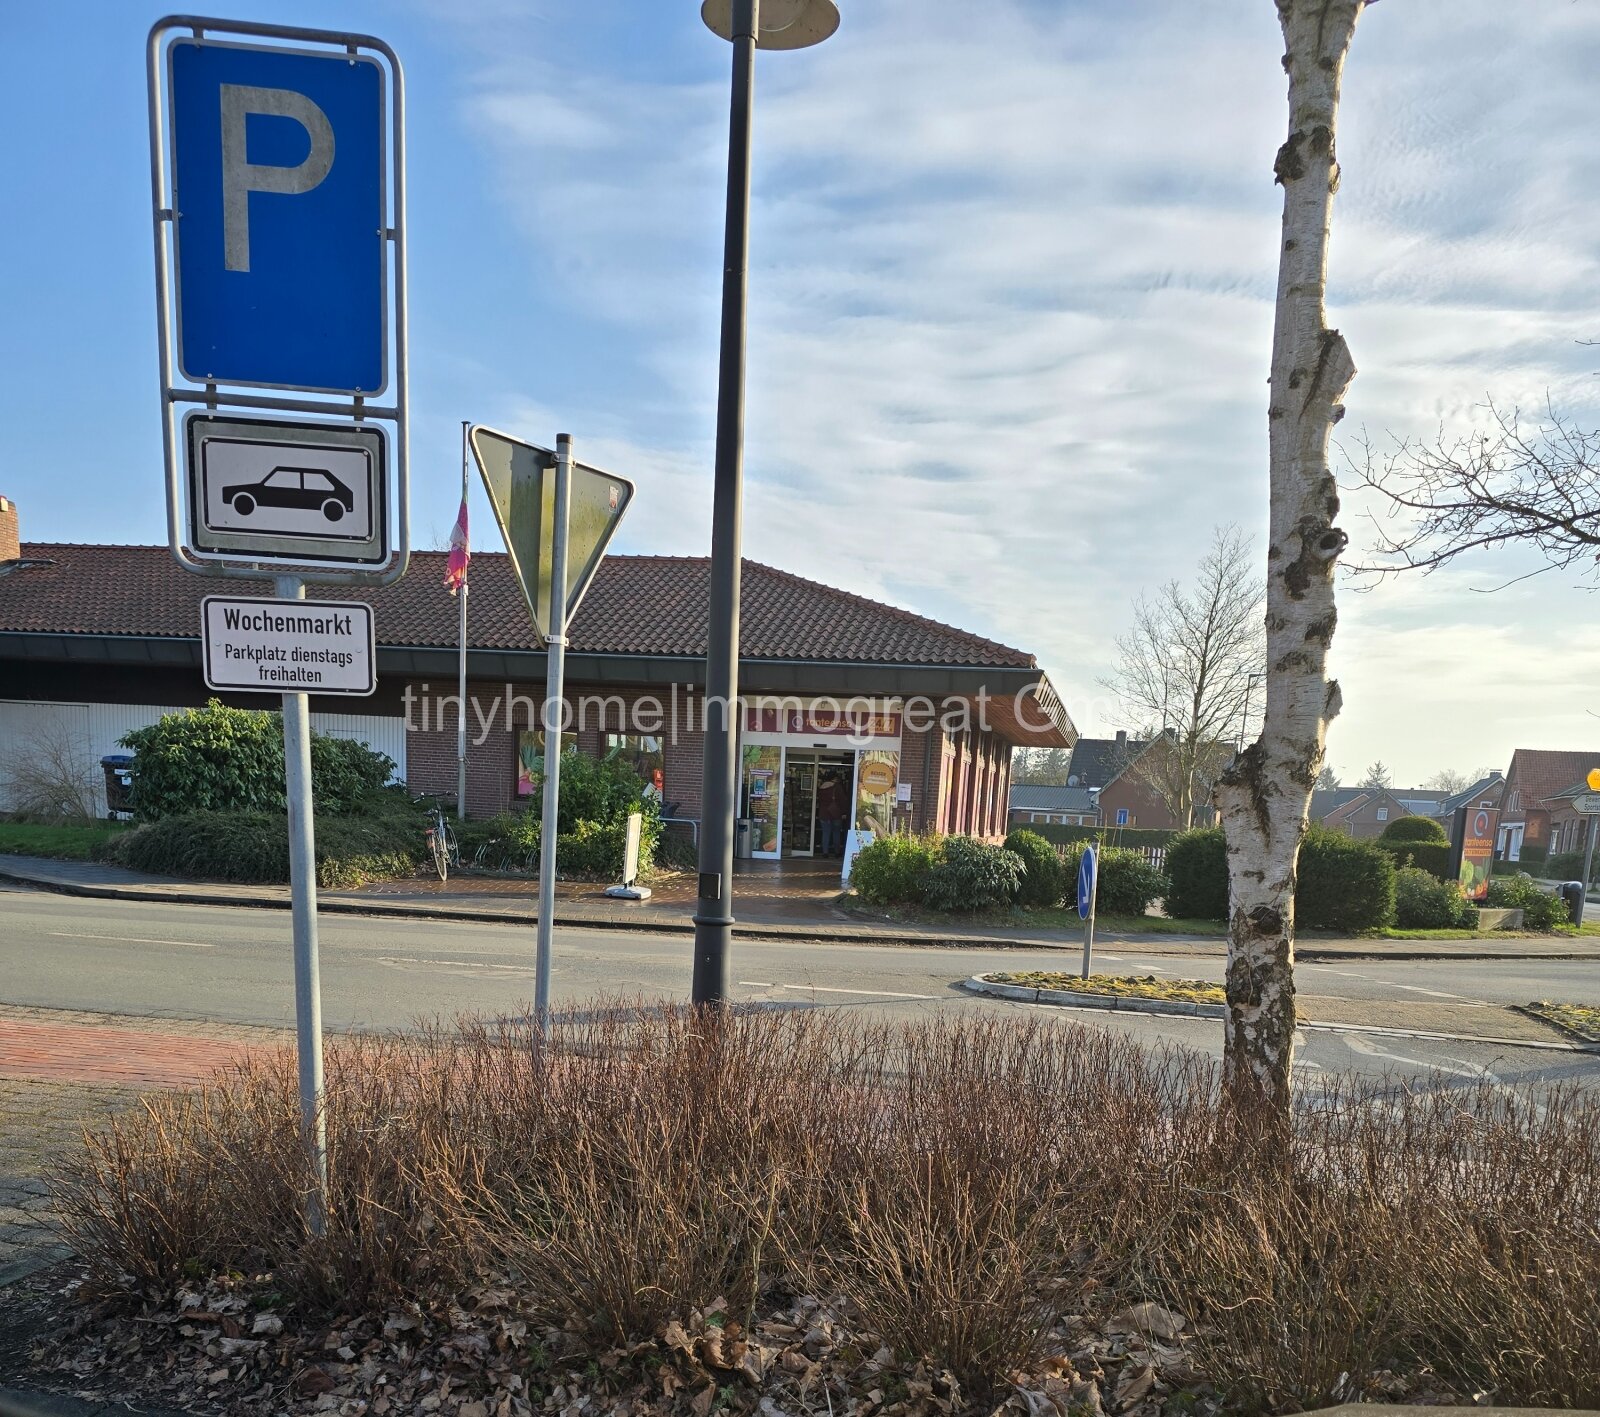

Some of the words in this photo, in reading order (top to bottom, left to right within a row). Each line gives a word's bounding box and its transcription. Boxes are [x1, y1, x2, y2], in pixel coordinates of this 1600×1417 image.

[219, 82, 336, 273] P
[223, 608, 352, 636] Wochenmarkt
[225, 643, 287, 664] Parkplatz
[291, 646, 353, 668] dienstags
[258, 665, 322, 683] freihalten
